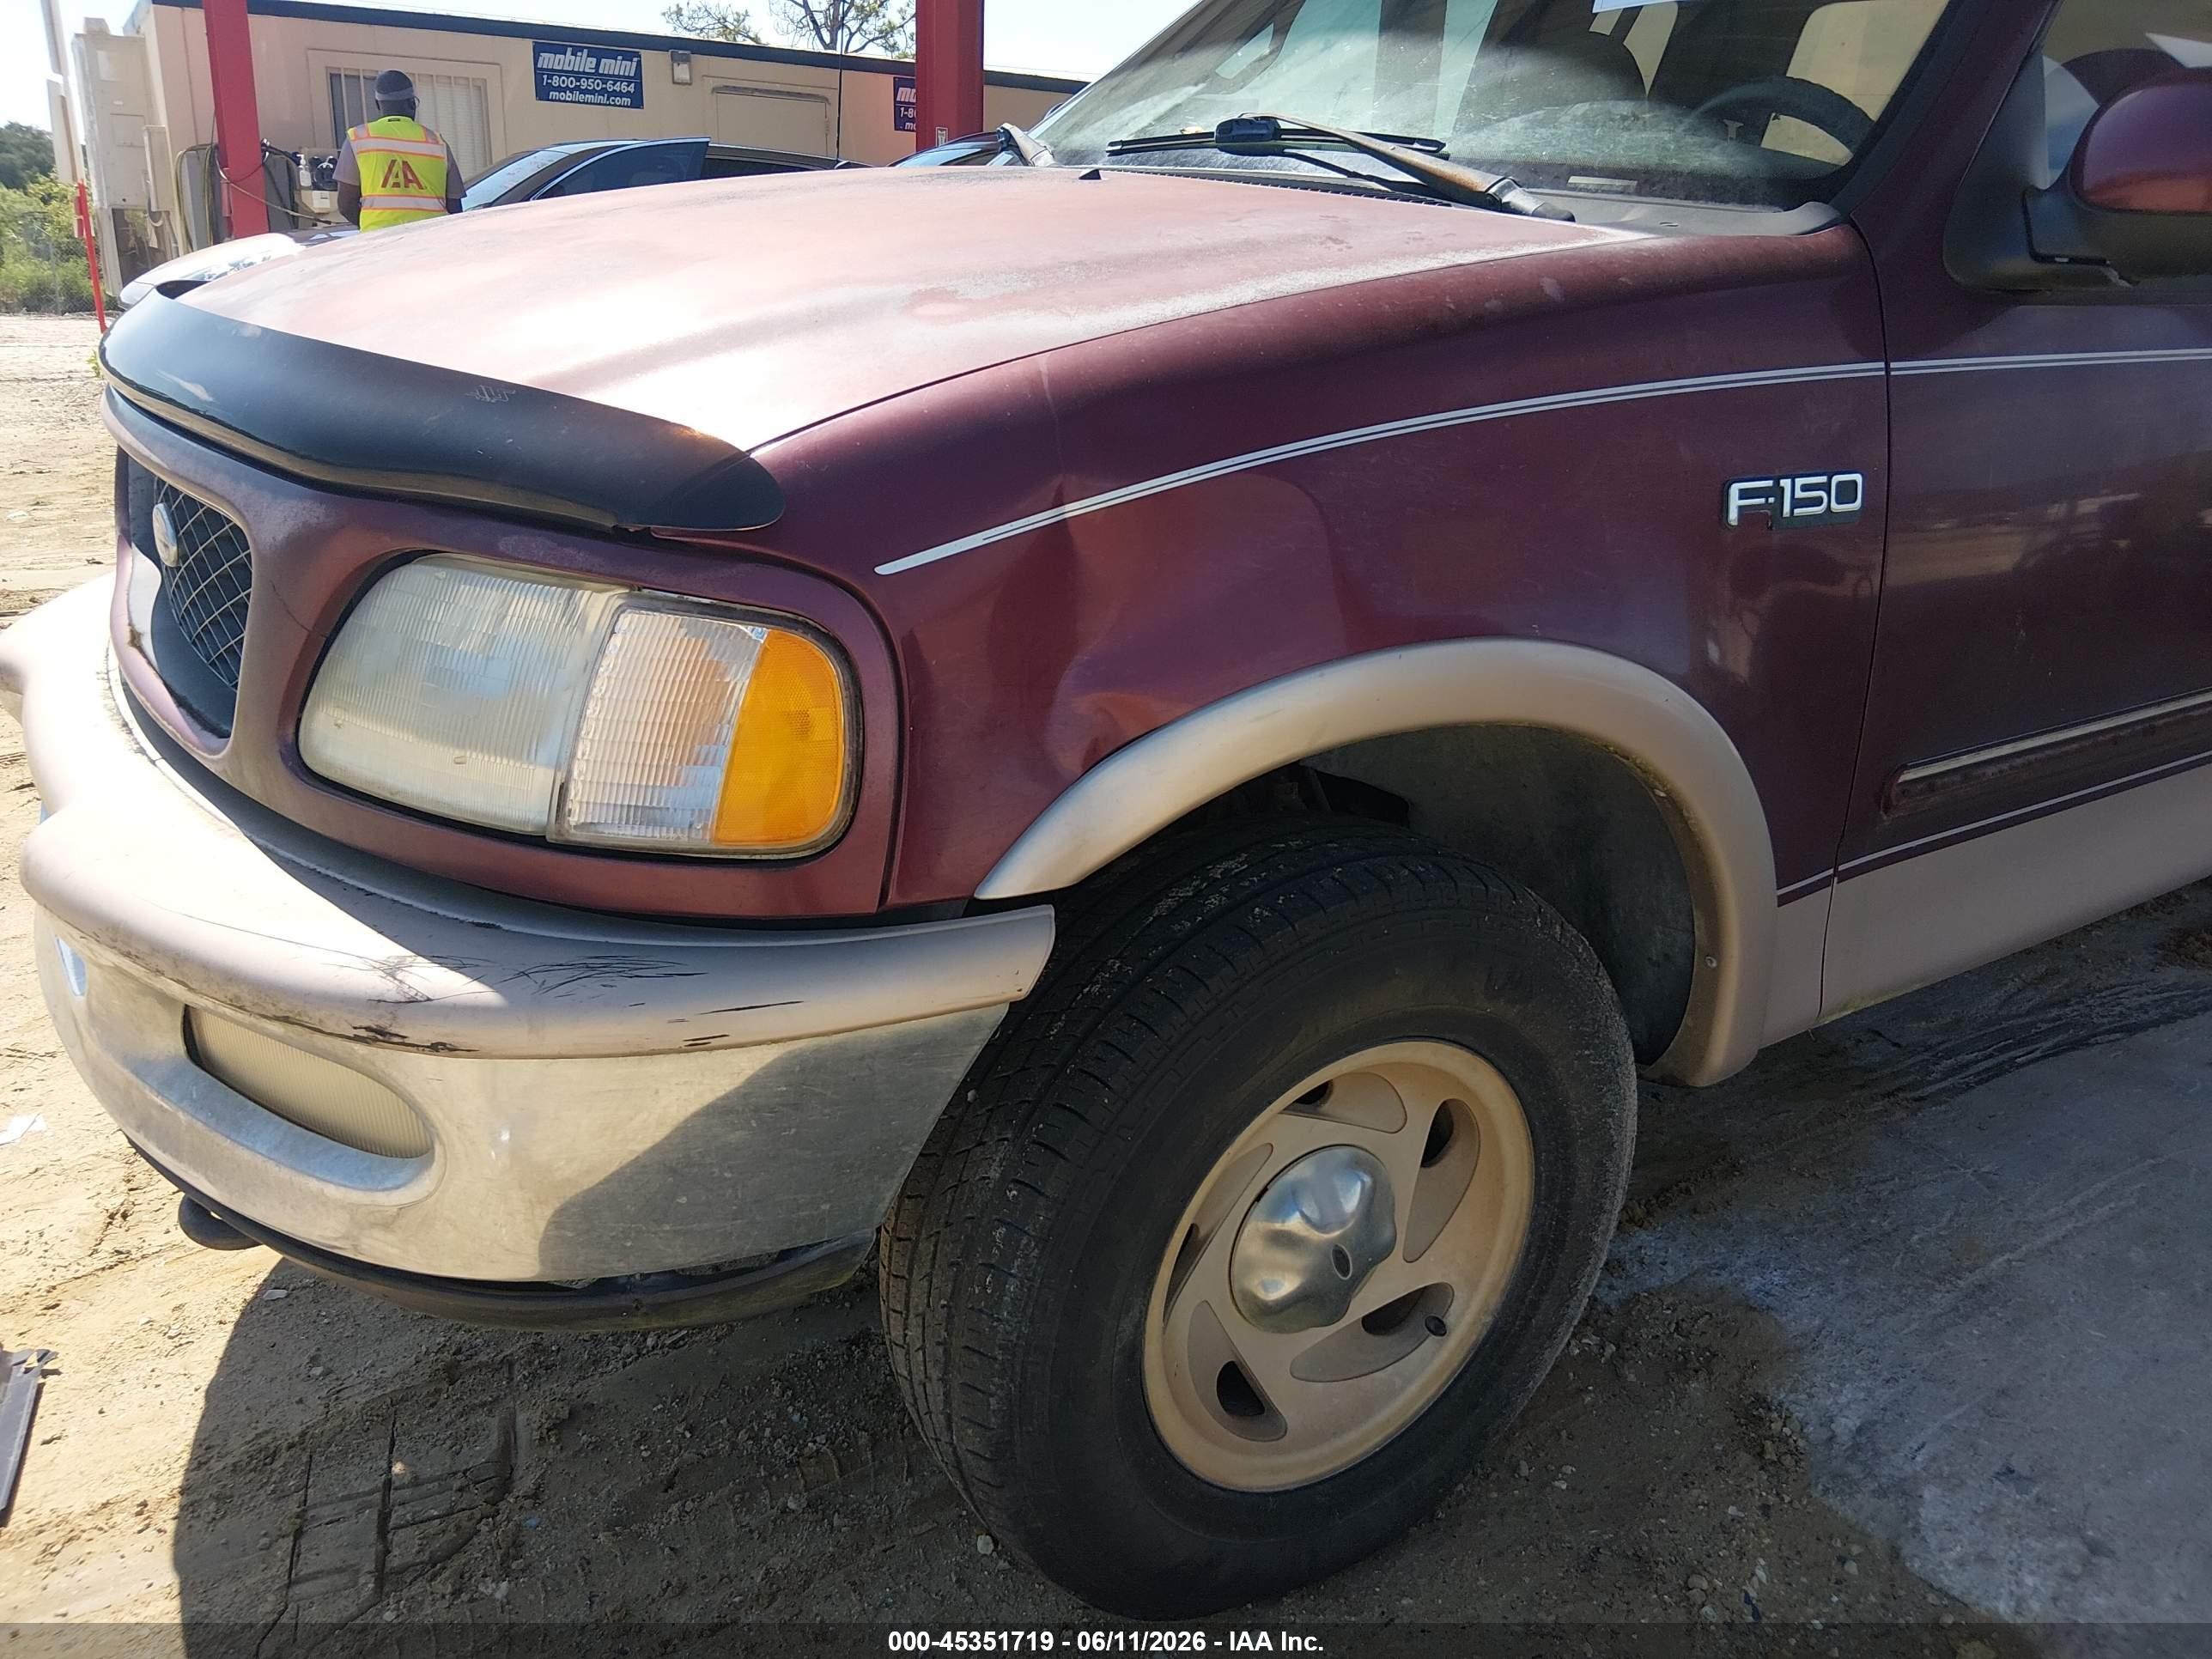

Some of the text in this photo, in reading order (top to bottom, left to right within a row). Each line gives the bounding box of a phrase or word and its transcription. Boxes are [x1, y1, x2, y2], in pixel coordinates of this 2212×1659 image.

[537, 47, 638, 76] mobile mini
[542, 75, 635, 94] 1-800-950-6464
[549, 90, 631, 106] mobilemini.com
[1728, 473, 1863, 526] F-150
